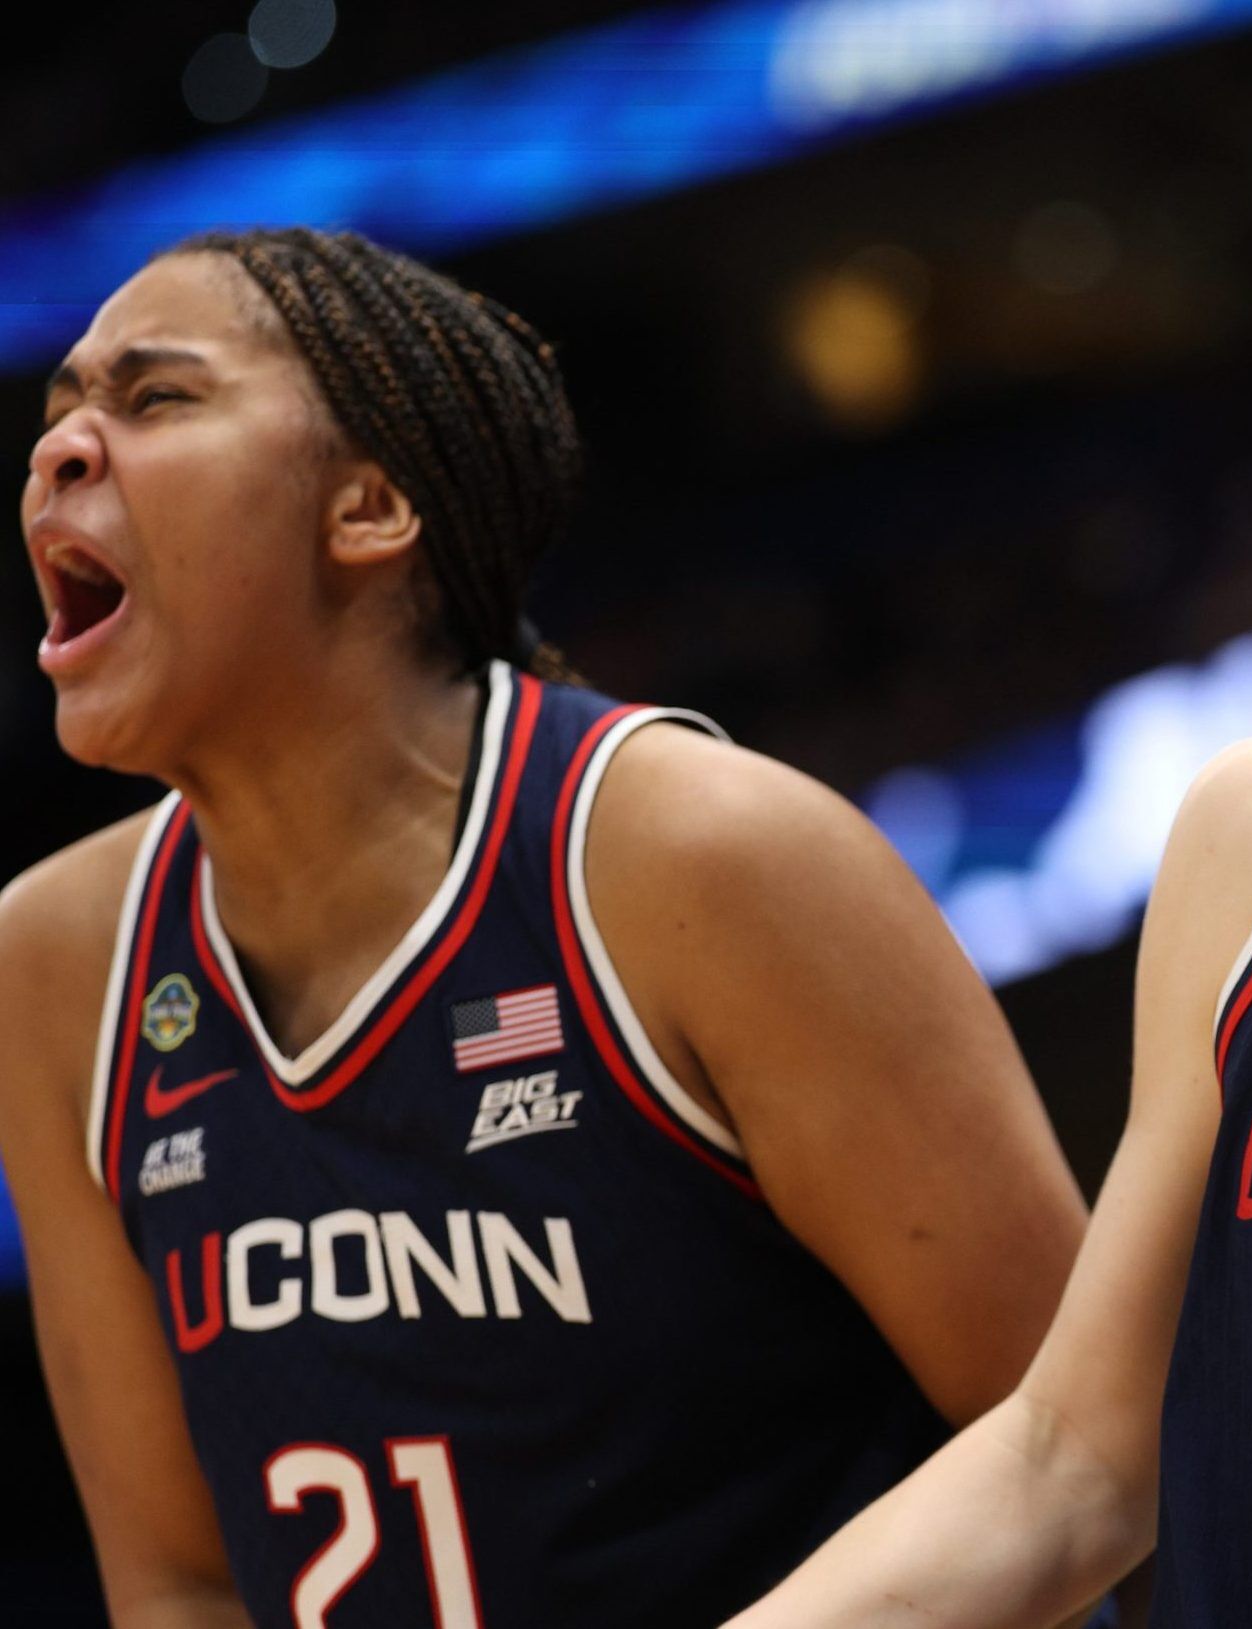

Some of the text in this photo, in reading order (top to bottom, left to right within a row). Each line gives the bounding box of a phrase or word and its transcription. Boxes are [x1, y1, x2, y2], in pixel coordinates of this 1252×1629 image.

[470, 1089, 585, 1138] EAST
[479, 1069, 558, 1110] BIG
[137, 1150, 206, 1197] CHANGE
[165, 1207, 593, 1354] UCONN
[261, 1434, 488, 1629] 21
